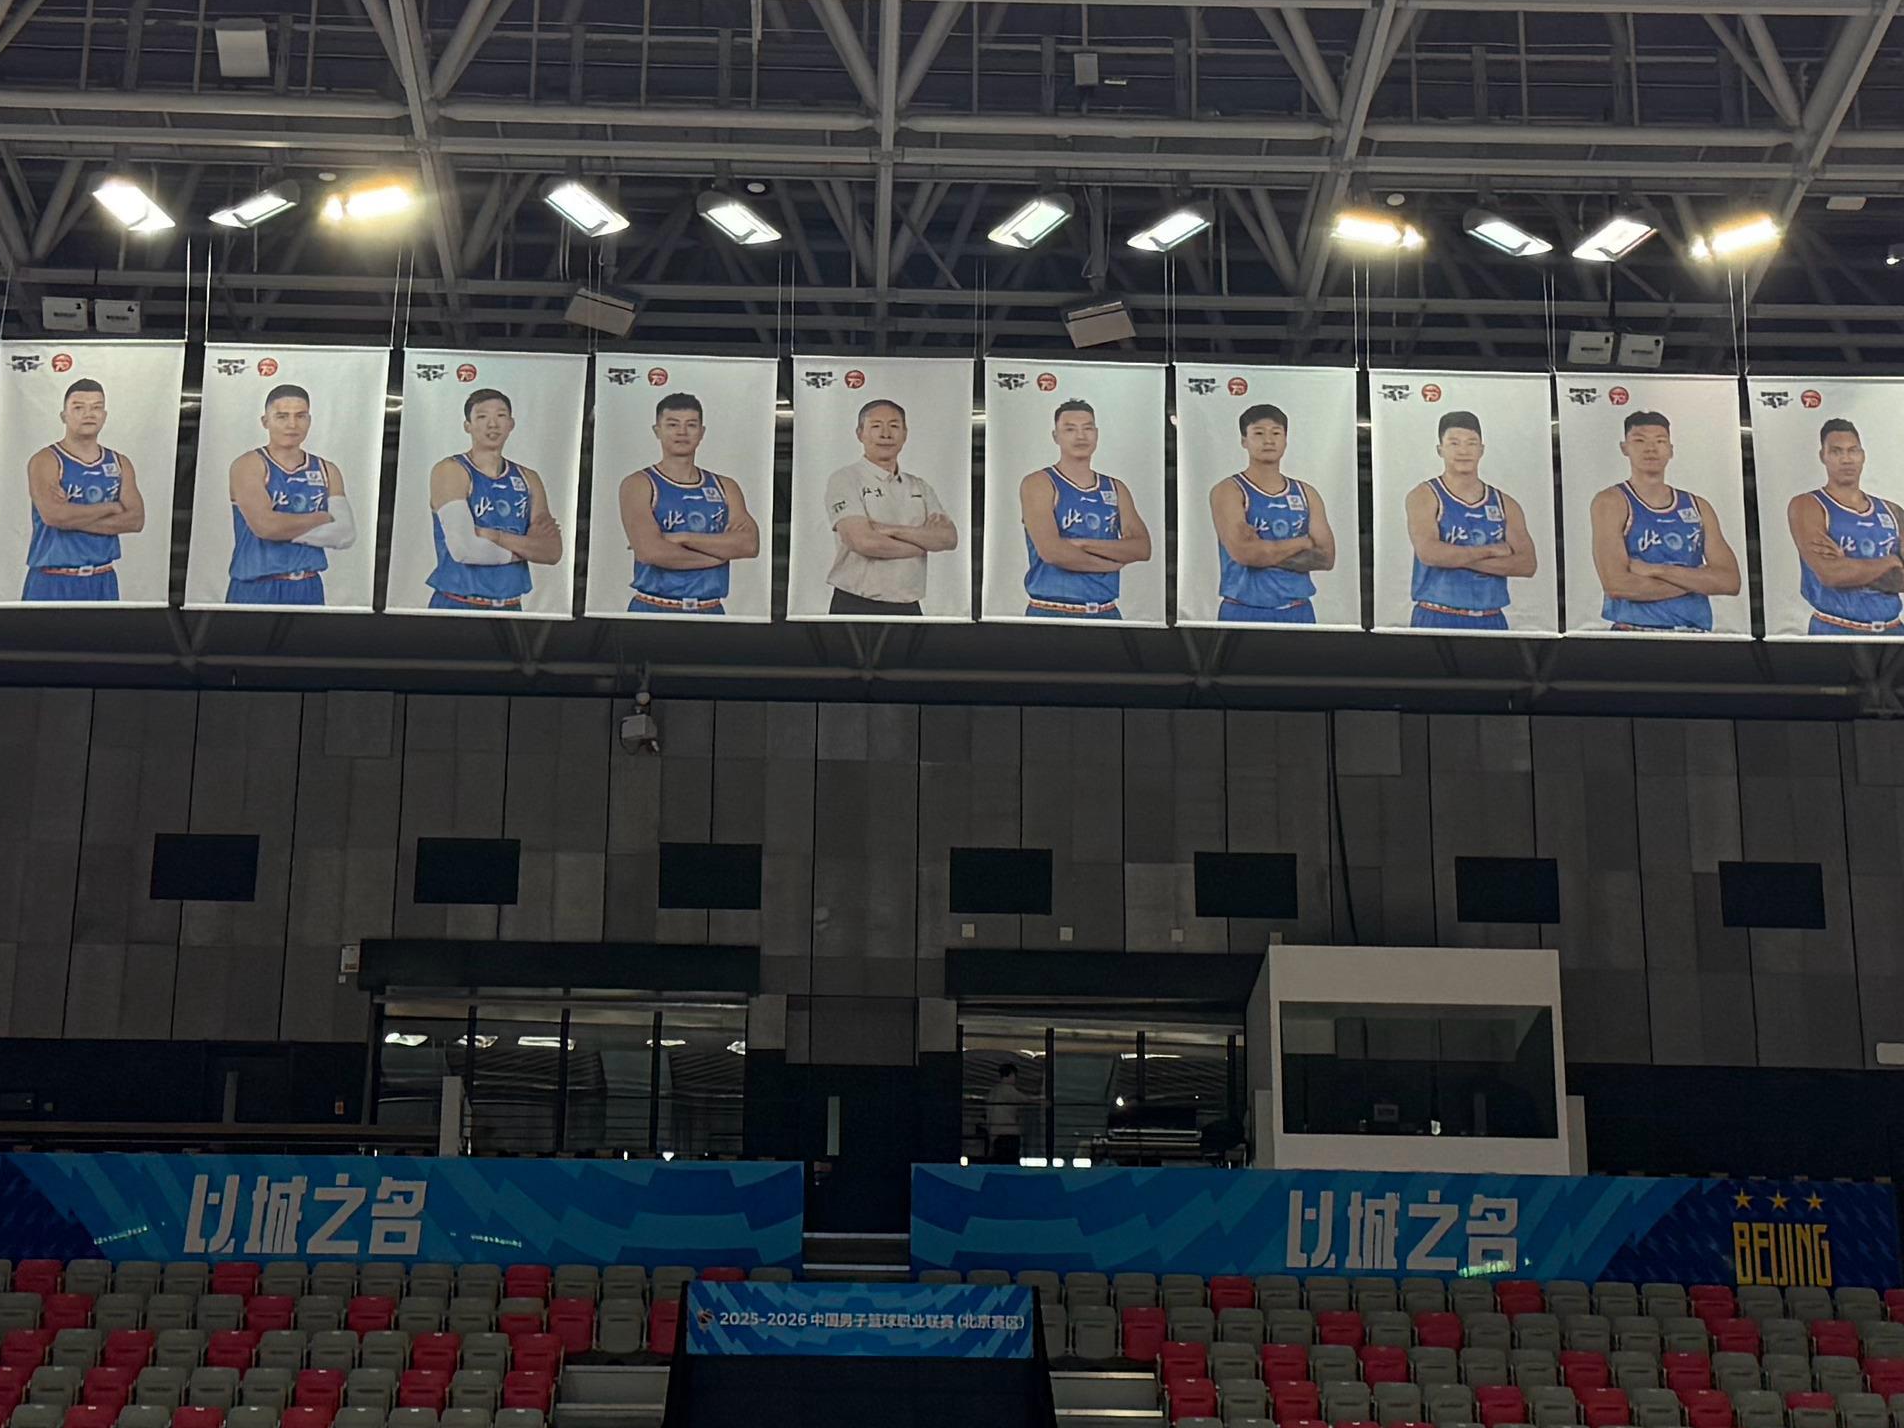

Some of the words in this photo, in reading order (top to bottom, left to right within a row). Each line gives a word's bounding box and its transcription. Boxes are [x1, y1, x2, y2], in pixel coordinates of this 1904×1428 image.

[182, 1174, 427, 1256] 以城之名
[1286, 1191, 1518, 1274] 以城之名
[1733, 1222, 1831, 1287] BEIJING
[720, 1312, 807, 1327] 2025-2026
